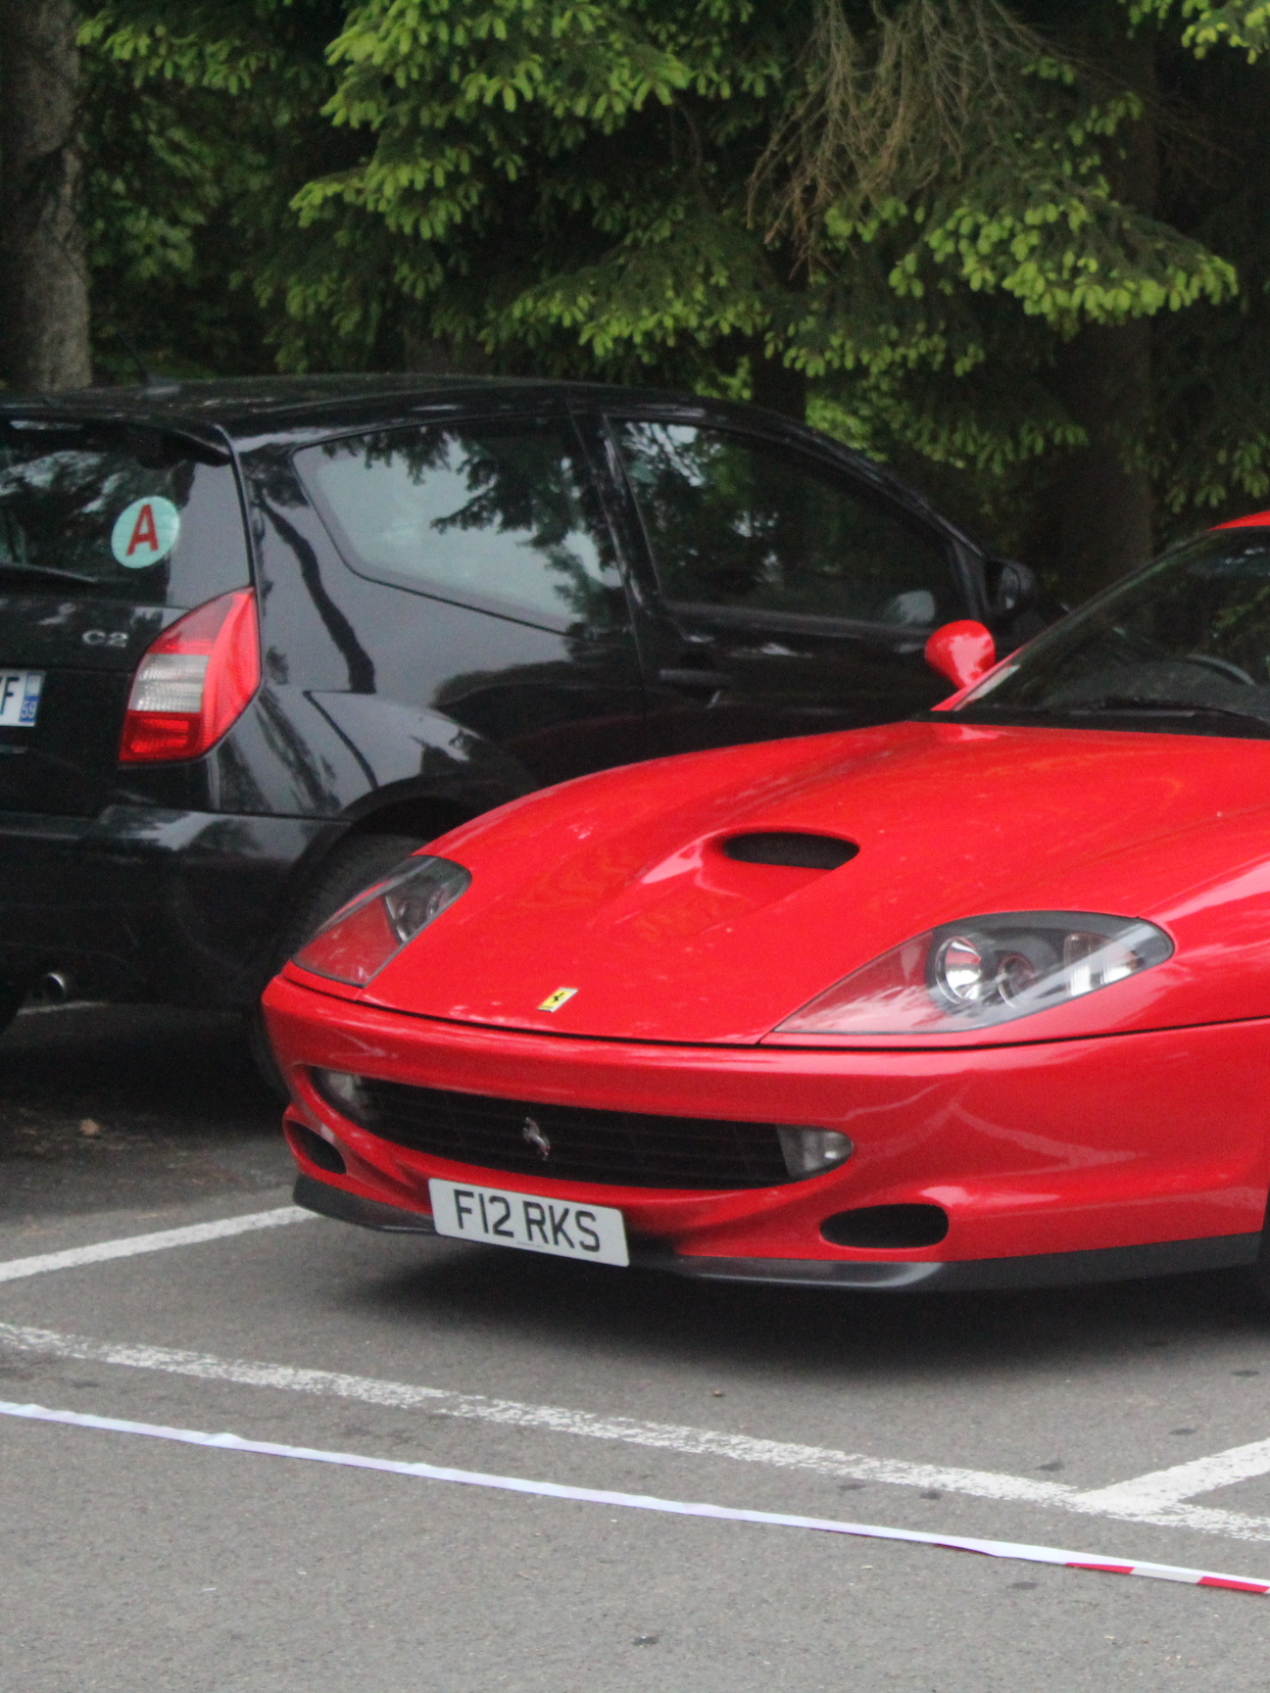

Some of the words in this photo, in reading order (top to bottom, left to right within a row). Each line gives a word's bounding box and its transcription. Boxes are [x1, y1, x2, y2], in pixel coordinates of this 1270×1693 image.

[126, 504, 159, 556] A
[82, 630, 129, 648] C2
[453, 1189, 514, 1238] F12
[523, 1201, 600, 1253] RKS
